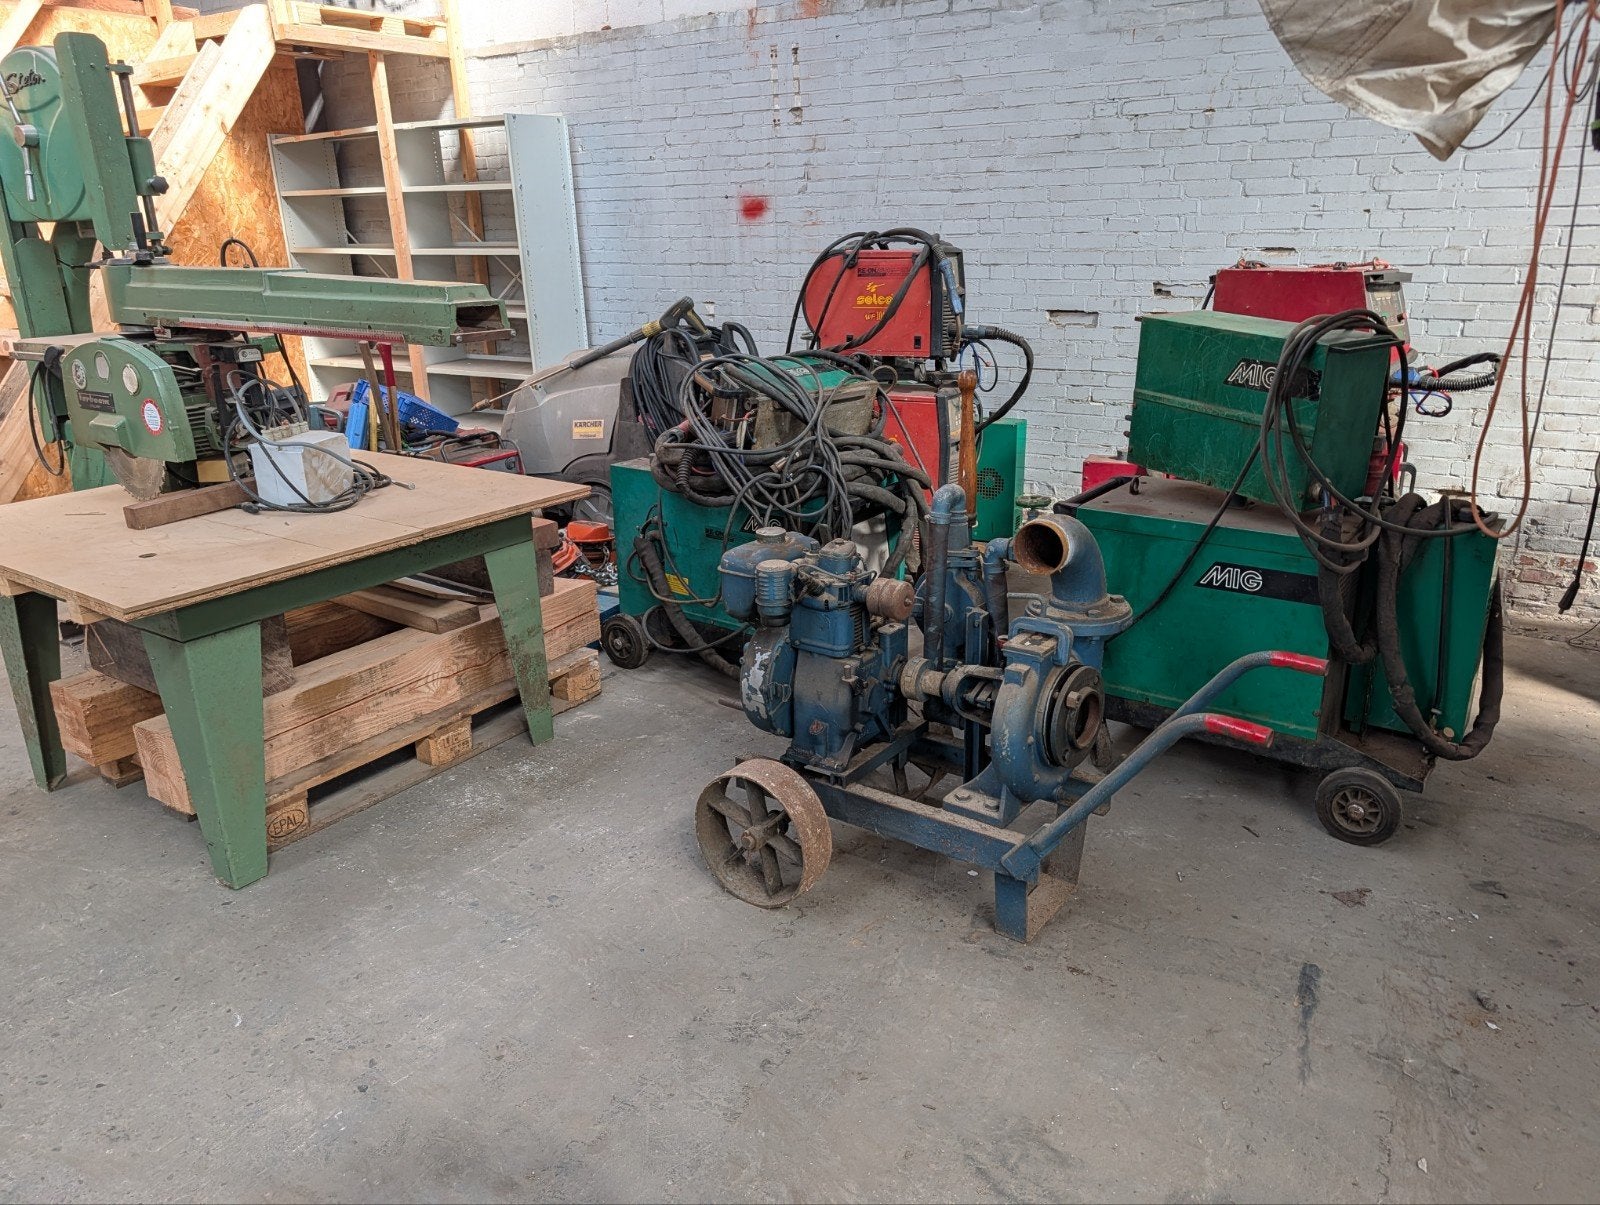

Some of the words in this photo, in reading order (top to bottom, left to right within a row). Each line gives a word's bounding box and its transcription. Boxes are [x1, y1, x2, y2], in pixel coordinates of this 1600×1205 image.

[856, 294, 893, 305] selco
[1200, 565, 1263, 592] MIG
[272, 813, 302, 836] EPAL
